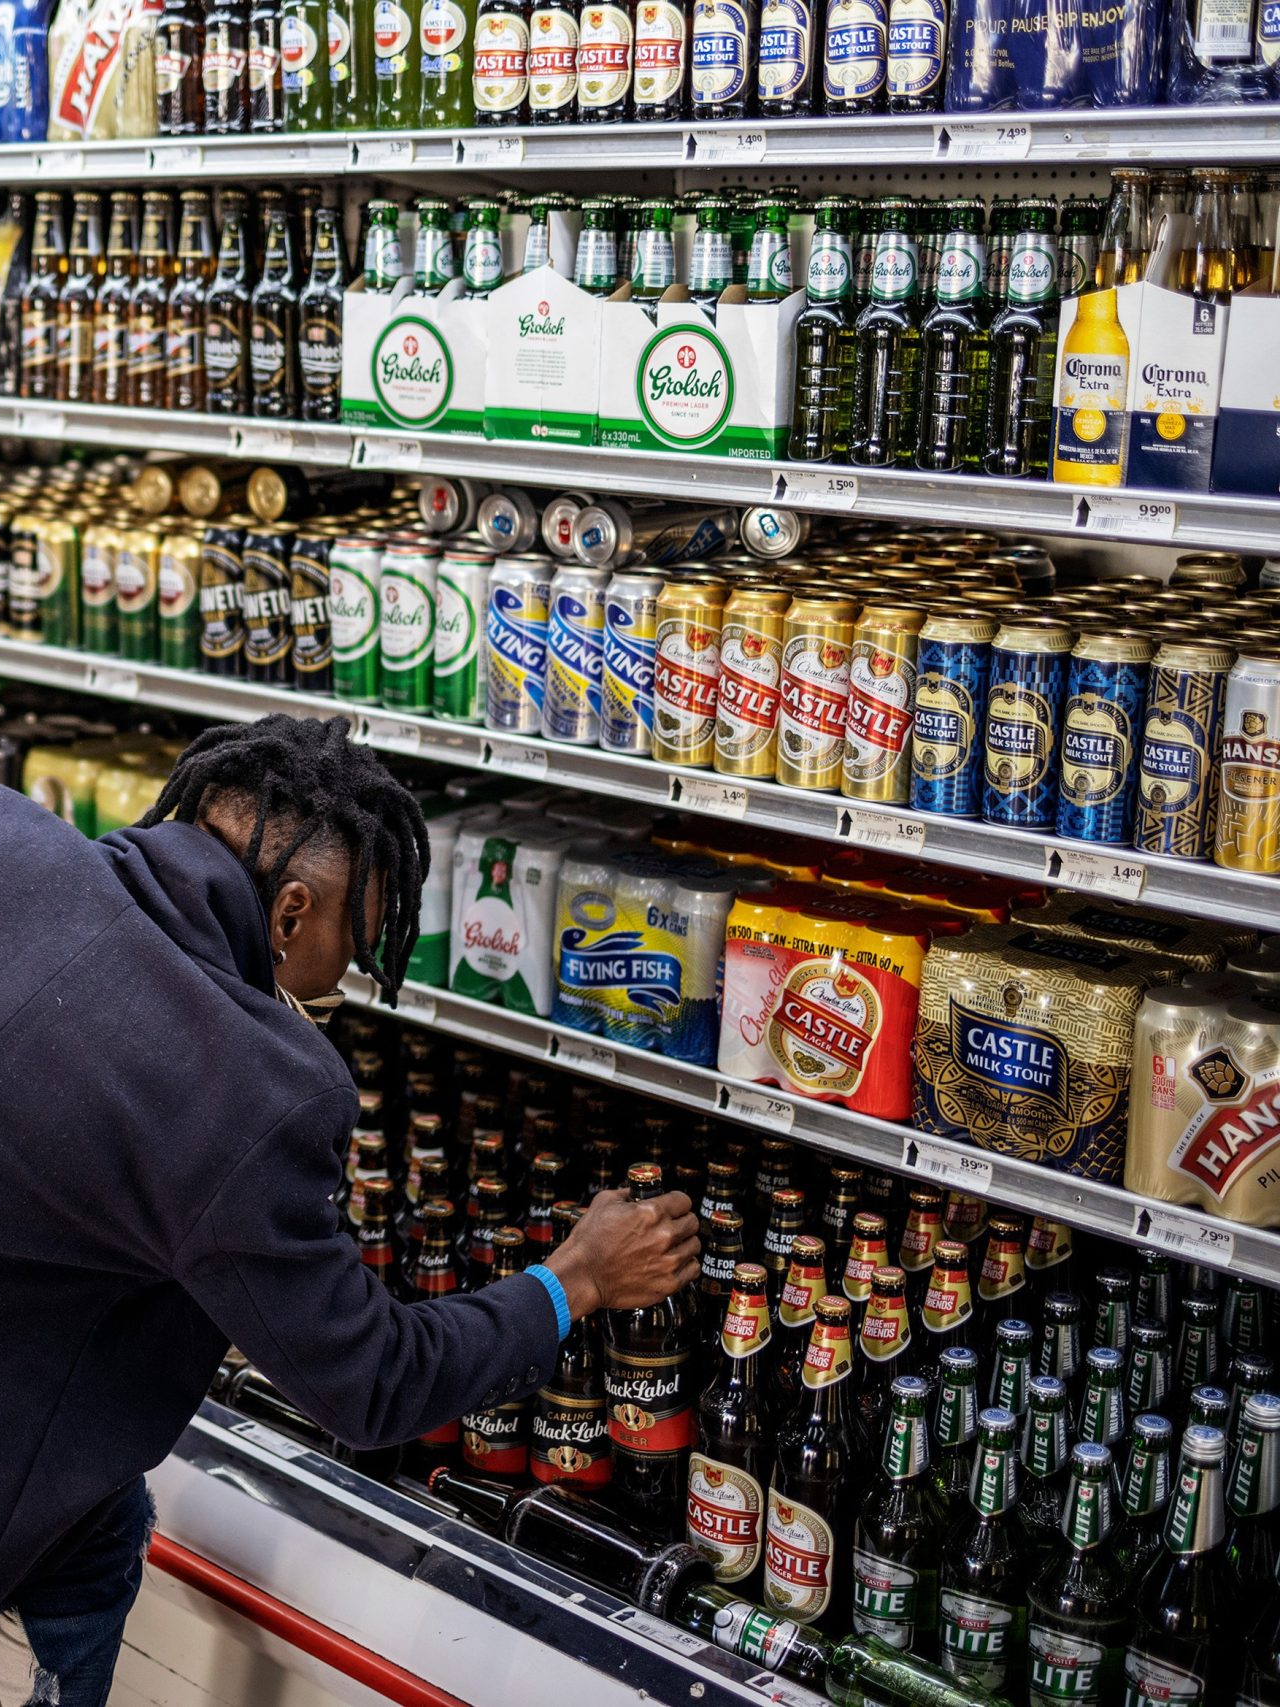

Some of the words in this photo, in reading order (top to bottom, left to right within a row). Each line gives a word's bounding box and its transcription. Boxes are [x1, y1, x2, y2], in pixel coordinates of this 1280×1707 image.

[966, 20, 1006, 34] POUR
[1011, 16, 1048, 32] PAUSE
[1056, 13, 1078, 28] SIP
[1082, 5, 1125, 28] ENJOY
[829, 30, 875, 46] CASTLE
[889, 27, 931, 41] CASTLE
[693, 39, 734, 52] CASTLE
[772, 48, 793, 58] STOUT
[846, 45, 875, 55] STOUT
[904, 42, 930, 51] STOUT
[475, 55, 523, 69] CASTLE
[529, 53, 572, 68] CASTLE
[639, 62, 656, 70] LAGER
[706, 53, 733, 61] STOUT
[485, 69, 504, 77] LAGER
[536, 68, 553, 76] LAGER
[586, 65, 604, 73] LAGER
[809, 263, 845, 278] Grolsch
[875, 262, 911, 278] Grolsch
[1010, 264, 1049, 280] Grolsch
[1201, 309, 1209, 321] 6
[518, 314, 566, 337] Grolsch
[380, 353, 442, 385] Grolsch
[1065, 358, 1121, 379] Corona
[1142, 363, 1207, 386] Corona
[649, 364, 723, 401] Grolsch
[1080, 376, 1109, 391] Extra
[1157, 383, 1192, 399] Extra
[662, 400, 688, 409] PREMIUM
[691, 402, 709, 410] LAGER
[728, 447, 770, 460] IMPORTED
[330, 596, 366, 618] olsch
[383, 604, 424, 626] olsch
[655, 661, 718, 707] CASTLE
[663, 690, 689, 709] LAGER
[719, 677, 776, 717] ASTLE
[780, 680, 848, 727] CASTLE
[792, 709, 819, 729] LAGER
[847, 695, 902, 739] ASTLE
[915, 711, 957, 729] CASTLE
[928, 727, 957, 739] STOUT
[989, 723, 1036, 741] CASTLE
[1004, 739, 1035, 750] STOUT
[1066, 734, 1114, 752] CASTLE
[1082, 750, 1114, 763] STOUT
[1143, 743, 1190, 764] CASTLE
[1223, 743, 1280, 763] HANS
[1159, 763, 1190, 775] STOUT
[1226, 769, 1278, 786] PILSENER
[463, 921, 520, 955] Grolsch
[727, 925, 737, 938] EW
[737, 925, 751, 939] 500
[768, 931, 786, 946] CAN
[792, 936, 815, 955] EXTRA
[856, 951, 878, 969] EXTRA
[879, 955, 892, 971] 60
[892, 964, 904, 977] ml
[566, 958, 626, 980] FLYING
[632, 960, 674, 981] FISH
[784, 1002, 864, 1058] CASTLE
[804, 1032, 833, 1054] LAGER
[968, 1026, 1054, 1070] CASTLE
[966, 1052, 1000, 1074] MILK
[1003, 1063, 1052, 1088] STOUT
[1152, 1055, 1165, 1076] 6
[1151, 1085, 1175, 1097] CANS
[1152, 1076, 1176, 1089] 500ml
[1010, 1105, 1049, 1121] SMOOTH
[716, 1199, 734, 1213] FOR
[717, 1258, 736, 1270] FOR
[942, 1294, 955, 1303] WITH
[724, 1321, 754, 1337] FRIENDS
[742, 1318, 755, 1327] WITH
[864, 1324, 896, 1339] FRIENDS
[883, 1321, 896, 1329] WITH
[820, 1349, 832, 1359] WITH
[1184, 1346, 1199, 1381] LITE
[610, 1367, 654, 1380] CARLING
[631, 1373, 680, 1402] Label
[998, 1377, 1015, 1413] LITE
[1129, 1370, 1144, 1405] LITE
[475, 1416, 518, 1434] Label
[547, 1410, 594, 1423] CARLING
[938, 1405, 953, 1441] LITE
[1083, 1407, 1098, 1442] LITE
[532, 1415, 573, 1440] Black
[888, 1436, 905, 1473] LITE
[1032, 1435, 1048, 1472] LITE
[980, 1474, 998, 1510] LITE
[1127, 1473, 1143, 1510] LITE
[1234, 1459, 1254, 1507] LITE
[687, 1498, 751, 1536] CASTLE
[1075, 1503, 1092, 1543] LITE
[1170, 1496, 1191, 1544] LITE
[700, 1526, 724, 1541] LAGER
[767, 1546, 821, 1578] ASTLE
[771, 1564, 793, 1580] LAGER
[865, 1577, 887, 1587] CASTLE
[854, 1581, 906, 1614] LITE
[960, 1619, 985, 1629] CASTLE
[945, 1623, 1004, 1653] LITE
[1048, 1656, 1073, 1666] CASTLE
[1032, 1660, 1094, 1692] LITE
[1141, 1685, 1167, 1697] CASTLE
